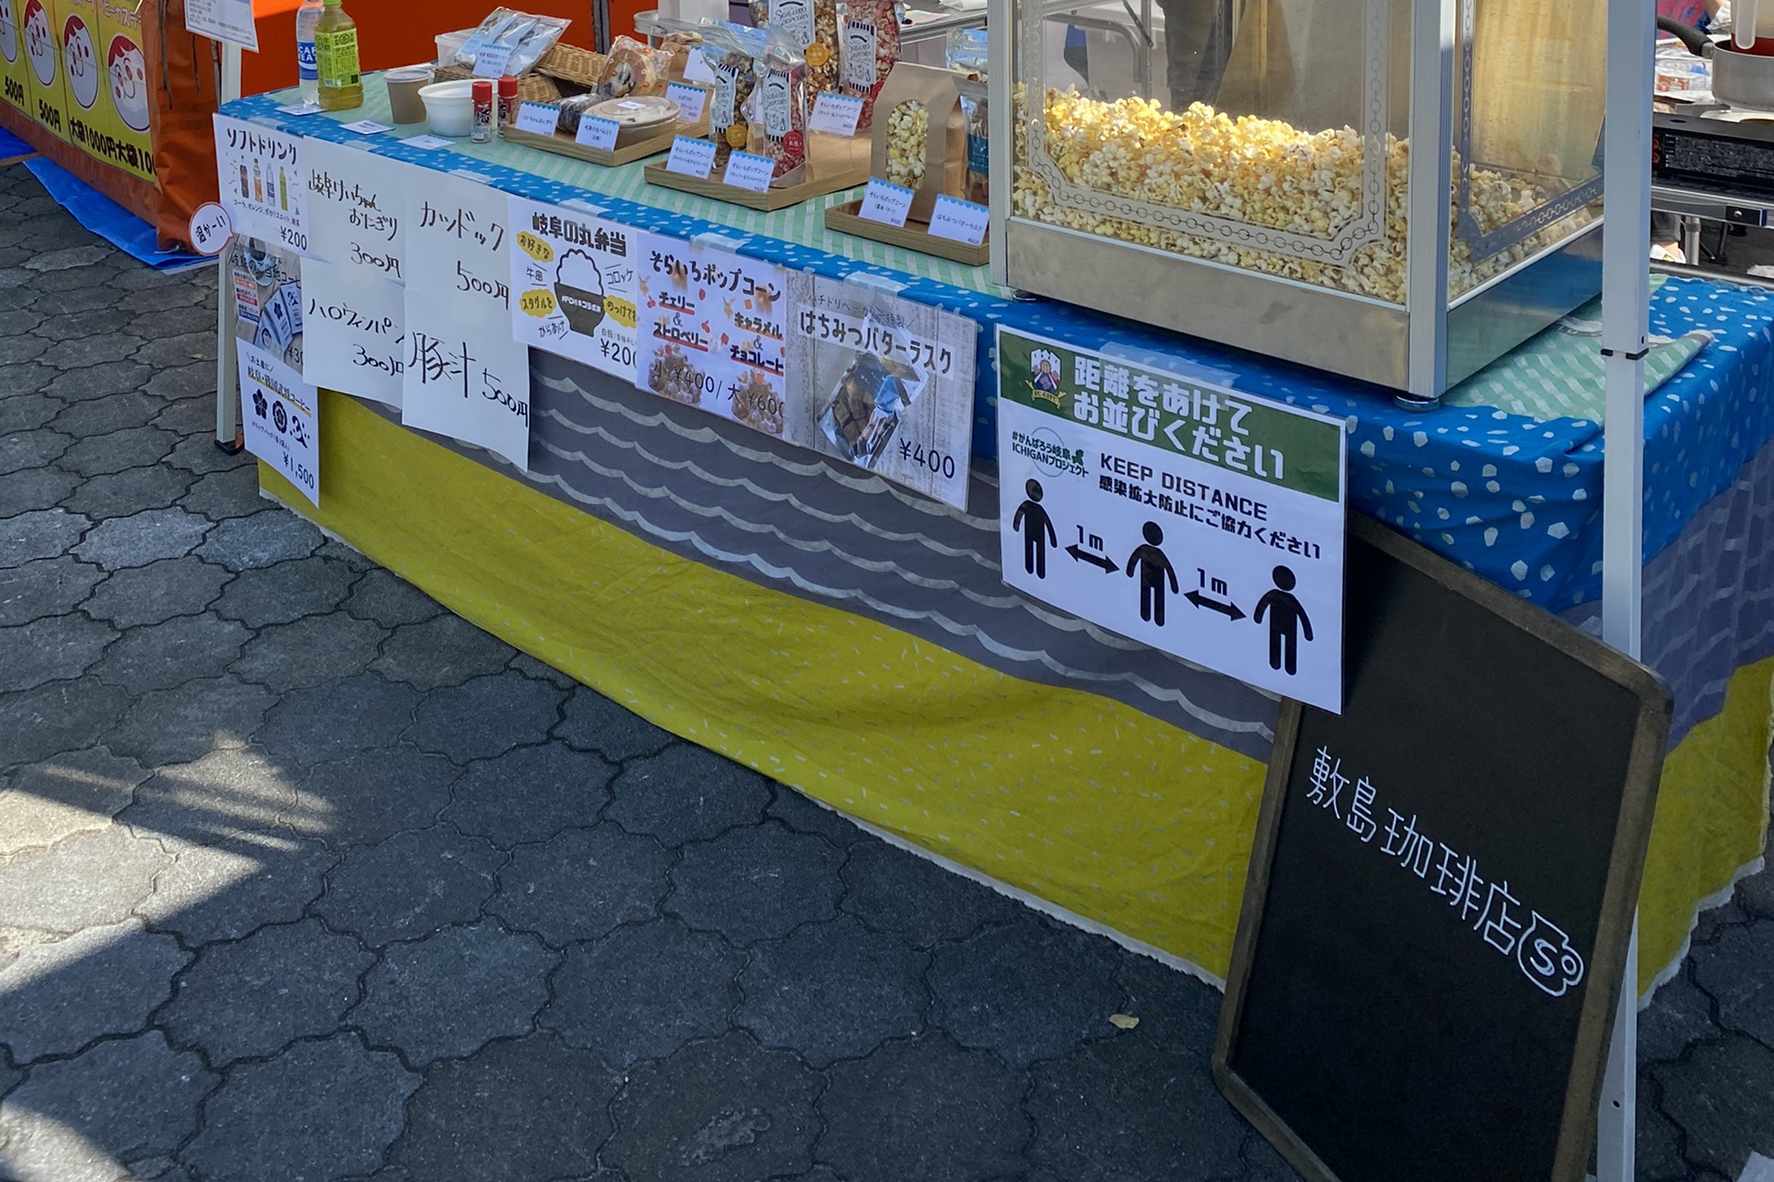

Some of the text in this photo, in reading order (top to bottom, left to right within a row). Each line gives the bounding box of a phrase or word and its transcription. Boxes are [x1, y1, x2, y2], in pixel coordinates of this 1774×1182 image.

[227, 128, 297, 165] ソフトドリンク
[280, 225, 308, 251] ¥200
[348, 208, 398, 242] おにぎり
[532, 212, 626, 257] 岐阜の丸弁当
[350, 242, 402, 279] 300円
[521, 234, 550, 260] お好きな
[457, 260, 510, 311] 500円
[606, 268, 634, 285] コロッケ
[650, 250, 781, 302] そらいろポップコーン
[658, 291, 695, 309] チェリー
[653, 322, 708, 345] ストロベリー
[672, 312, 683, 327] &
[734, 312, 783, 338] キャラメル
[730, 345, 784, 372] チョコレート
[753, 335, 764, 351] &
[800, 311, 952, 374] はちみつバターラスク
[408, 331, 477, 399] 豚汁
[653, 363, 668, 378] 小
[727, 384, 741, 404] 大
[482, 368, 529, 428] 500円
[1074, 356, 1253, 436] 距離をあけて
[1012, 430, 1071, 461] #がんばろう岐阜
[1073, 391, 1285, 480] お並びください
[283, 451, 315, 490] ¥1,500
[900, 438, 955, 479] ¥400
[1012, 442, 1089, 478] ICHIGANプロジェクト
[1100, 453, 1268, 521] KEEP DISTANCE
[1099, 475, 1321, 560] 感染拡大防止にご協力ください
[1076, 524, 1105, 552] 1m
[1197, 567, 1229, 596] 1m
[1306, 745, 1521, 955] 敷島珈琲店
